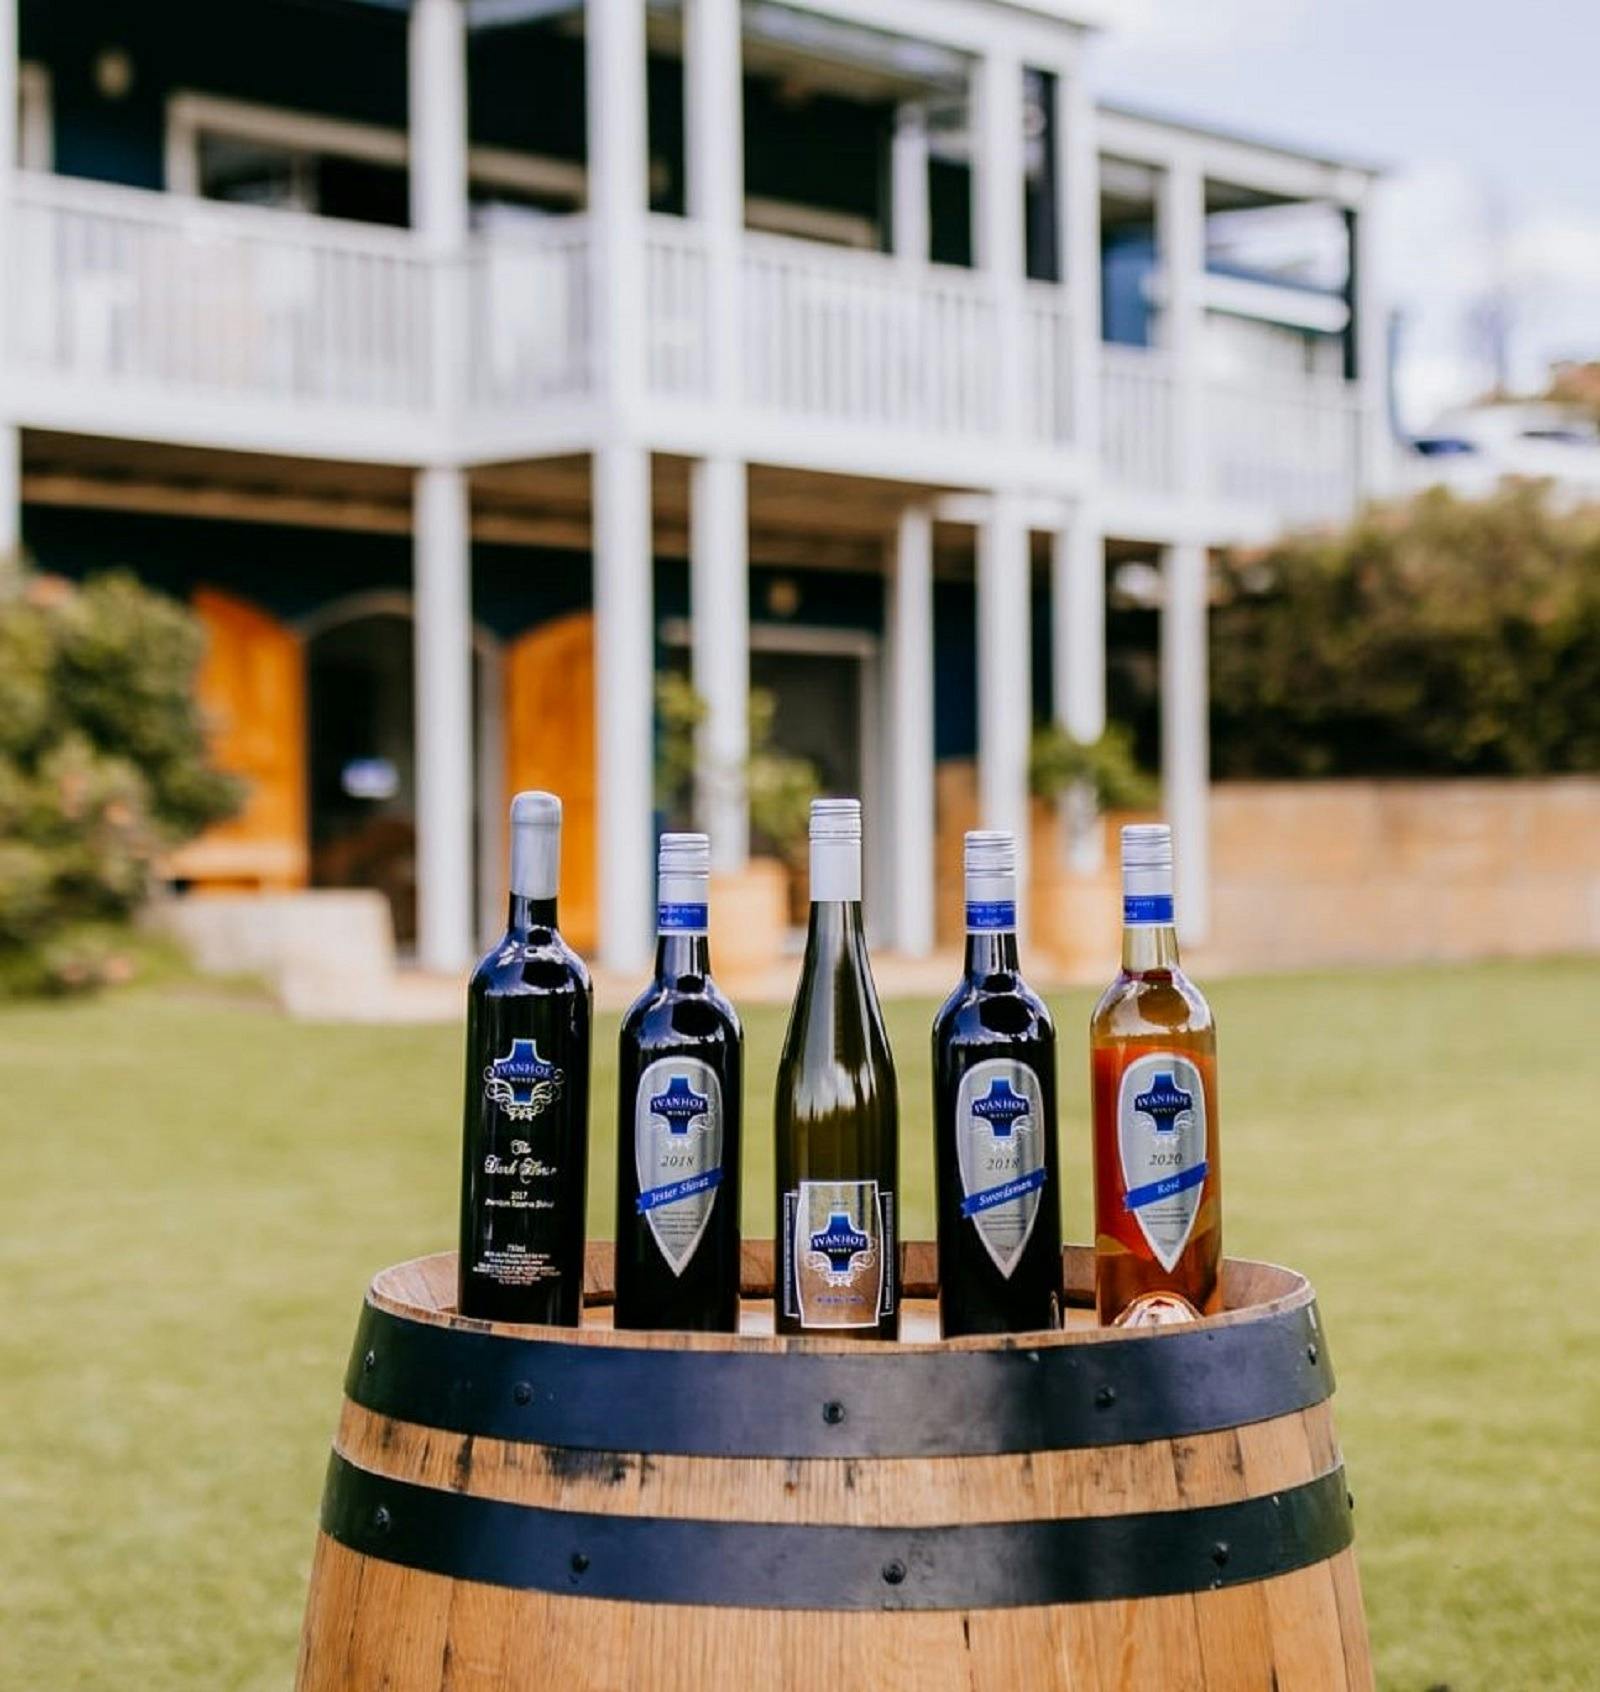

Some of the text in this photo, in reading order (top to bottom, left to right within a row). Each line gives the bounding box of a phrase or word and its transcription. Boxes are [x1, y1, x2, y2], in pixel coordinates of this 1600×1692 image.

[660, 1156, 694, 1167] 2018
[984, 1158, 1020, 1170] 2018
[1149, 1152, 1183, 1166] 2020
